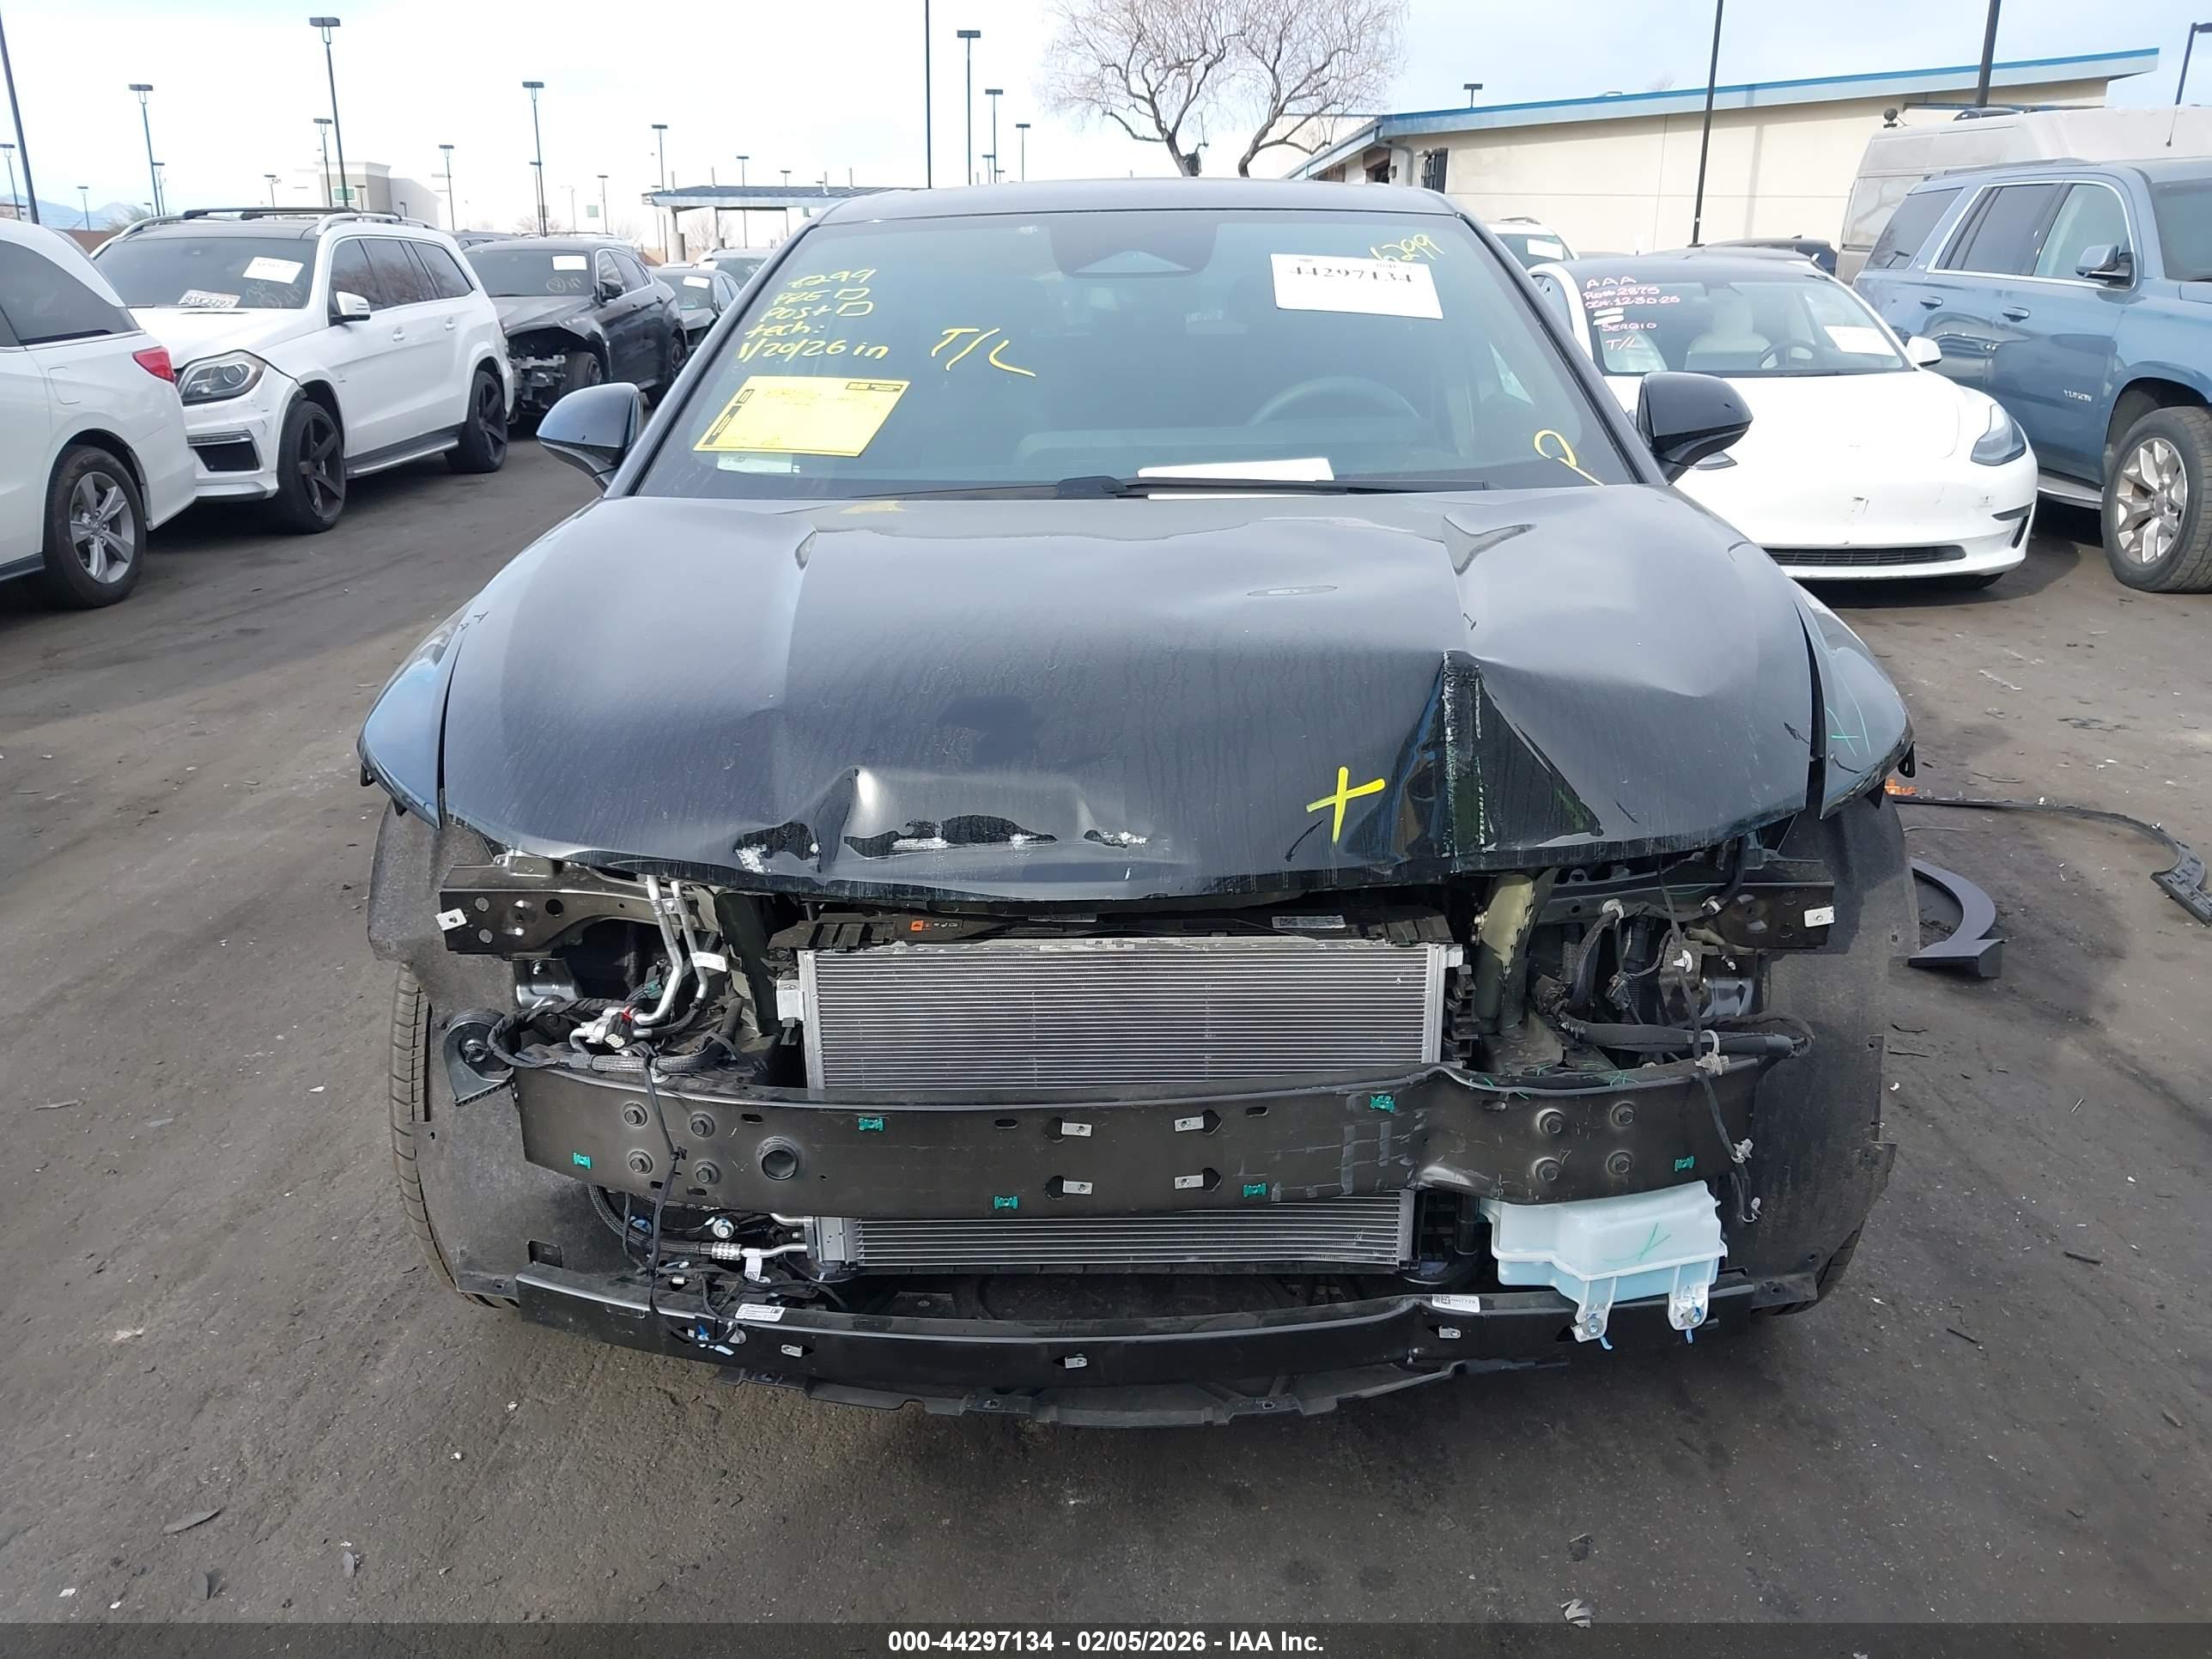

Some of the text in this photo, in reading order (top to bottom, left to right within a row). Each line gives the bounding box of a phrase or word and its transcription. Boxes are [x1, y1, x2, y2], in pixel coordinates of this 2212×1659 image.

[1289, 265, 1413, 283] 44297134
[1586, 276, 1638, 289] AAA
[853, 341, 890, 360] in
[1605, 336, 1644, 351] T/L
[930, 326, 1037, 378] T/L
[2063, 389, 2093, 403] YUKON
